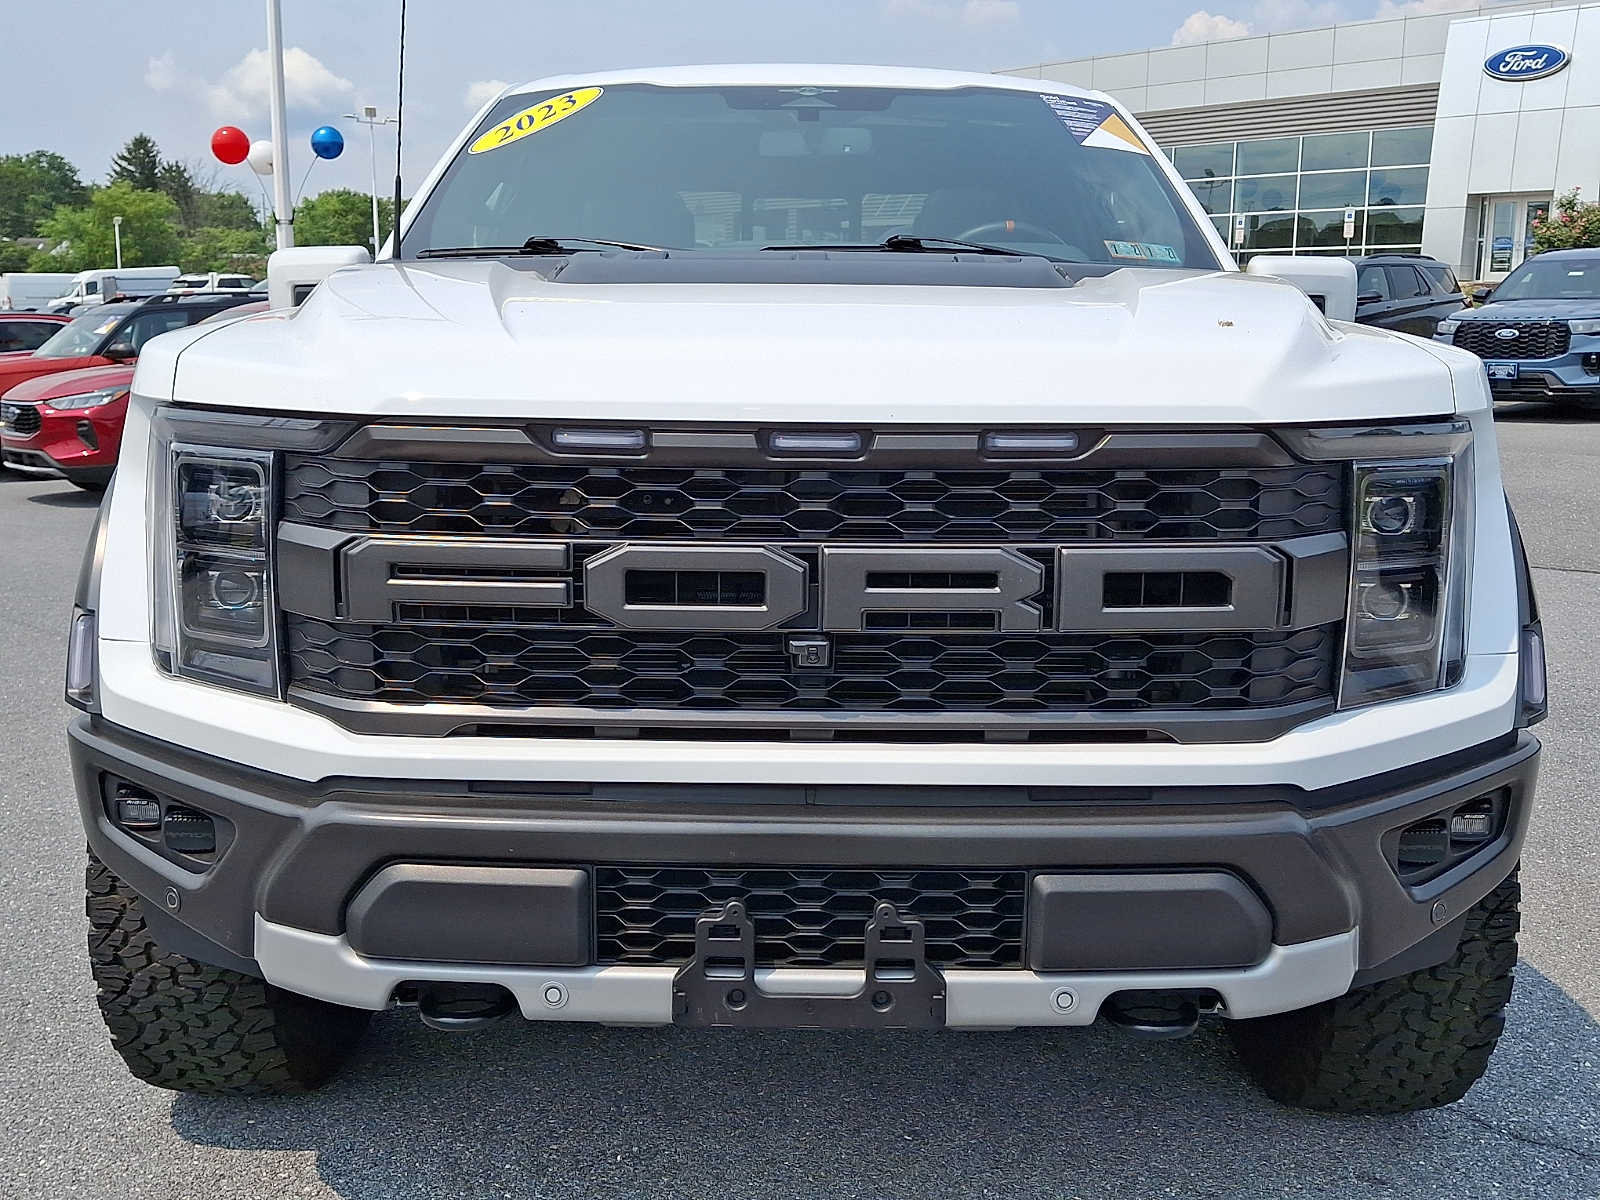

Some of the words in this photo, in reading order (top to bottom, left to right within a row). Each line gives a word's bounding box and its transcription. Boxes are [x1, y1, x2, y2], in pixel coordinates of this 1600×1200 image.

[1499, 50, 1549, 72] Ford
[494, 95, 577, 143] 2023
[341, 537, 1282, 632] FORD
